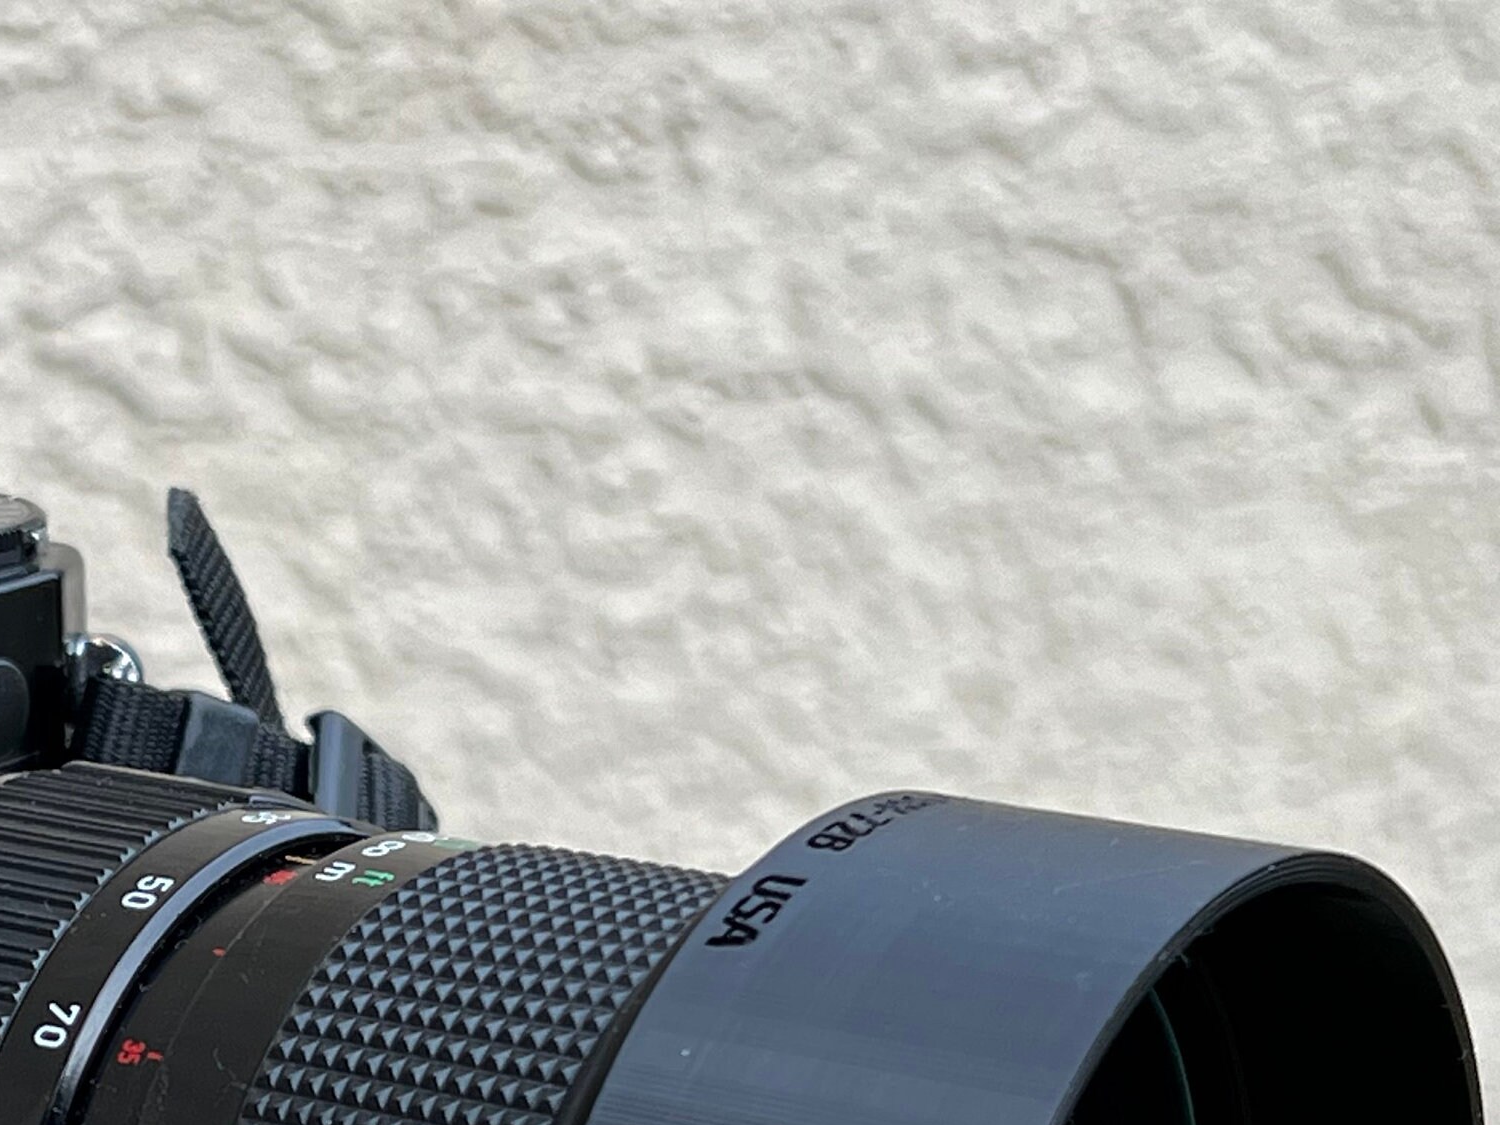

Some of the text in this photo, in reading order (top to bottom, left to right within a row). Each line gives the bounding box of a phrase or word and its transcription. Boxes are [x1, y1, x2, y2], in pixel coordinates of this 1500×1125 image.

[315, 861, 357, 882] m
[351, 869, 396, 888] ft
[120, 875, 176, 911] 50
[705, 873, 809, 947] USA
[33, 1002, 82, 1049] 70
[116, 1037, 146, 1066] 35
